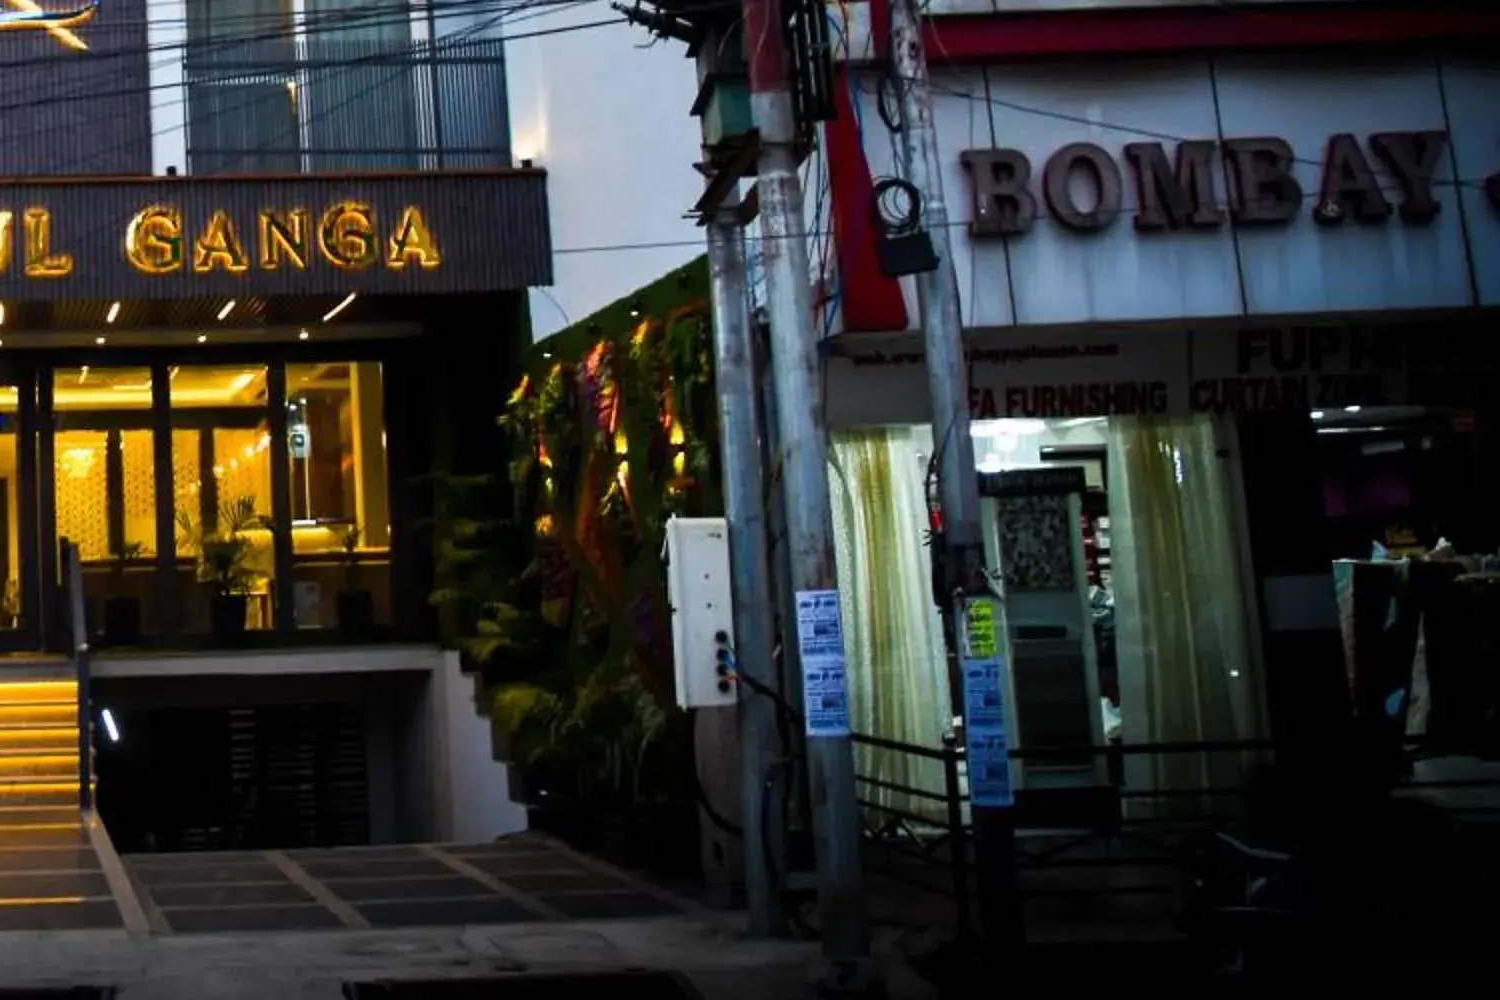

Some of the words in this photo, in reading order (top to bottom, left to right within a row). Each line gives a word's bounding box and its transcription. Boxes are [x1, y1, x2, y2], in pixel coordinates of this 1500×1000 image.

[961, 131, 1451, 237] BOMBAY
[125, 201, 443, 275] GANGA
[1006, 381, 1168, 418] FURNISHING
